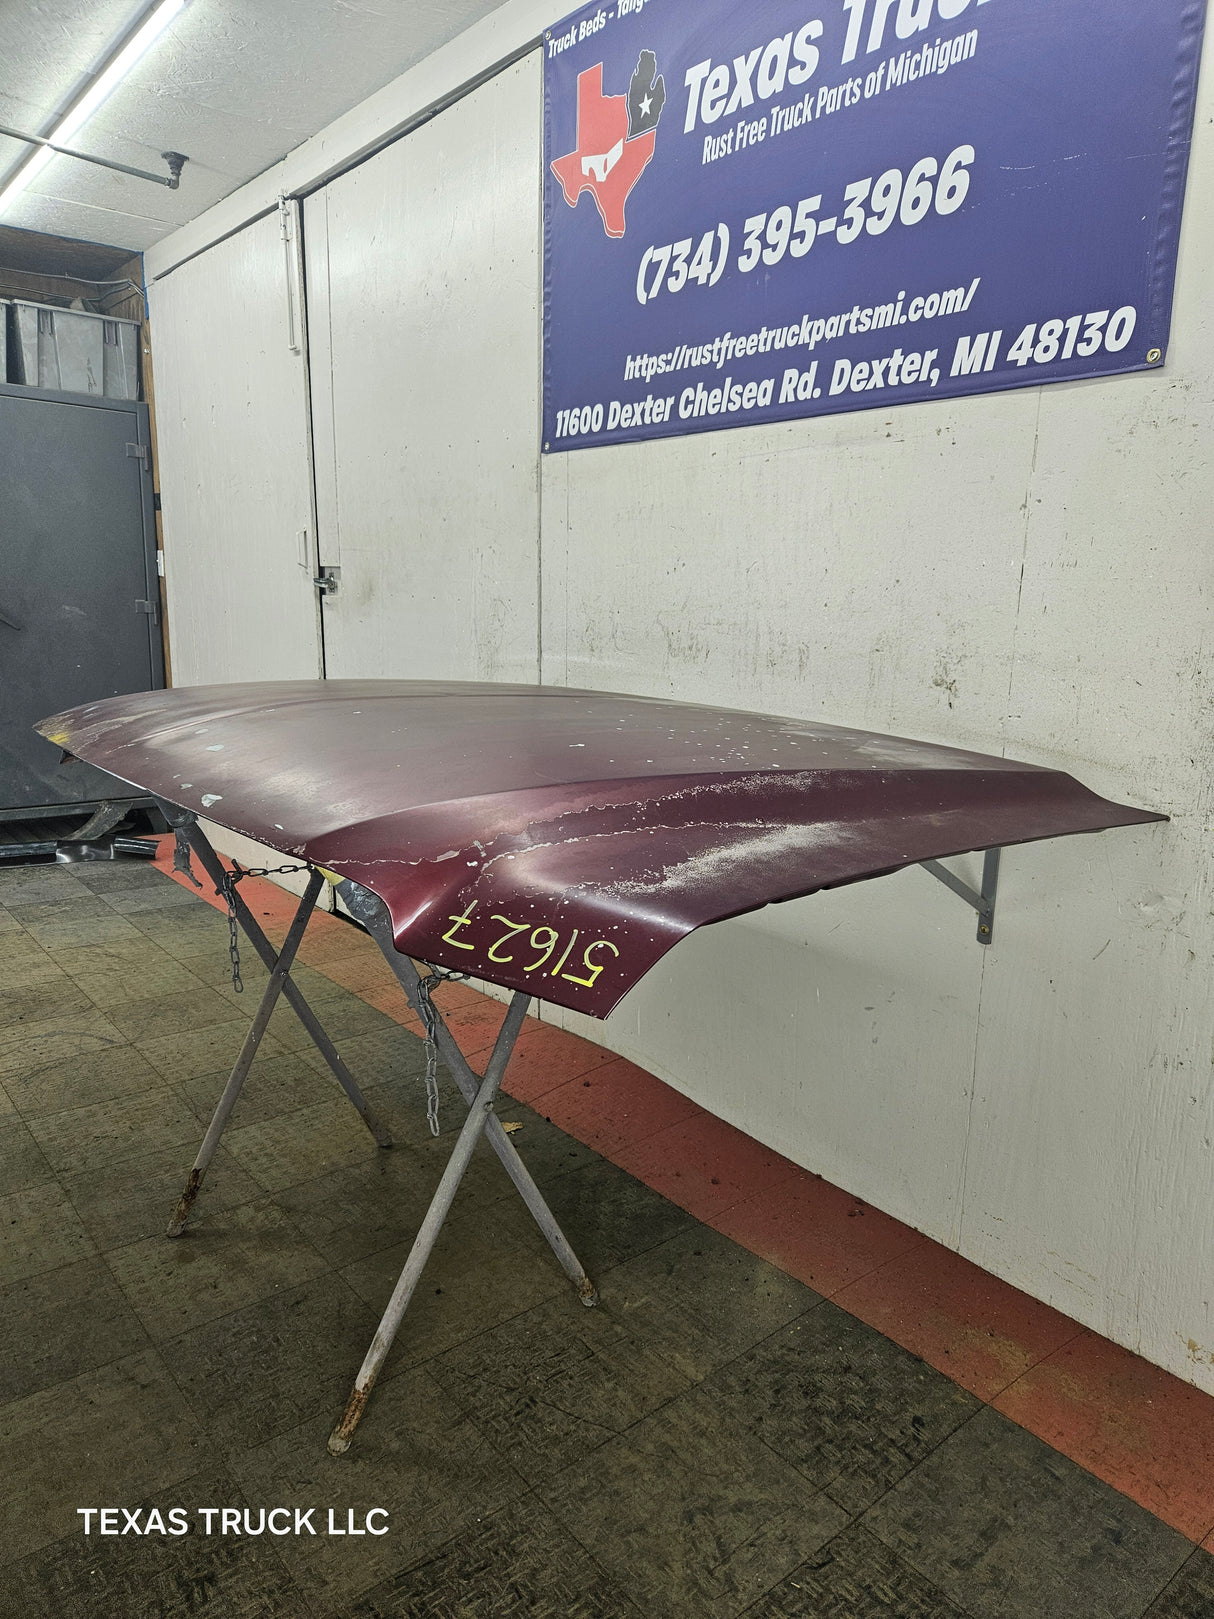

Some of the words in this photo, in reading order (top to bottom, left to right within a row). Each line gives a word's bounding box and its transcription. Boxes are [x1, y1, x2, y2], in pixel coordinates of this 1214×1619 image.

[548, 25, 578, 58] Truck
[578, 9, 607, 42] Beds
[684, 19, 824, 134] Texas
[841, 0, 991, 65] Tru
[702, 128, 734, 165] Rust
[735, 120, 767, 151] Free
[770, 92, 812, 138] Truck
[815, 76, 862, 119] Parts
[864, 63, 886, 99] of
[885, 29, 978, 90] Michigan
[636, 222, 730, 305] (734)
[738, 144, 975, 273] 395-3966
[555, 404, 603, 438] 11600
[606, 394, 675, 430] Dexter
[678, 377, 775, 420] Chelsea
[779, 361, 821, 404] Rd.
[828, 348, 939, 396] Dexter,
[950, 330, 1002, 377] MI
[1006, 305, 1137, 366] 48130
[624, 277, 981, 382] https://rustfreetruckpartsmi.com/
[441, 899, 620, 988] 51627
